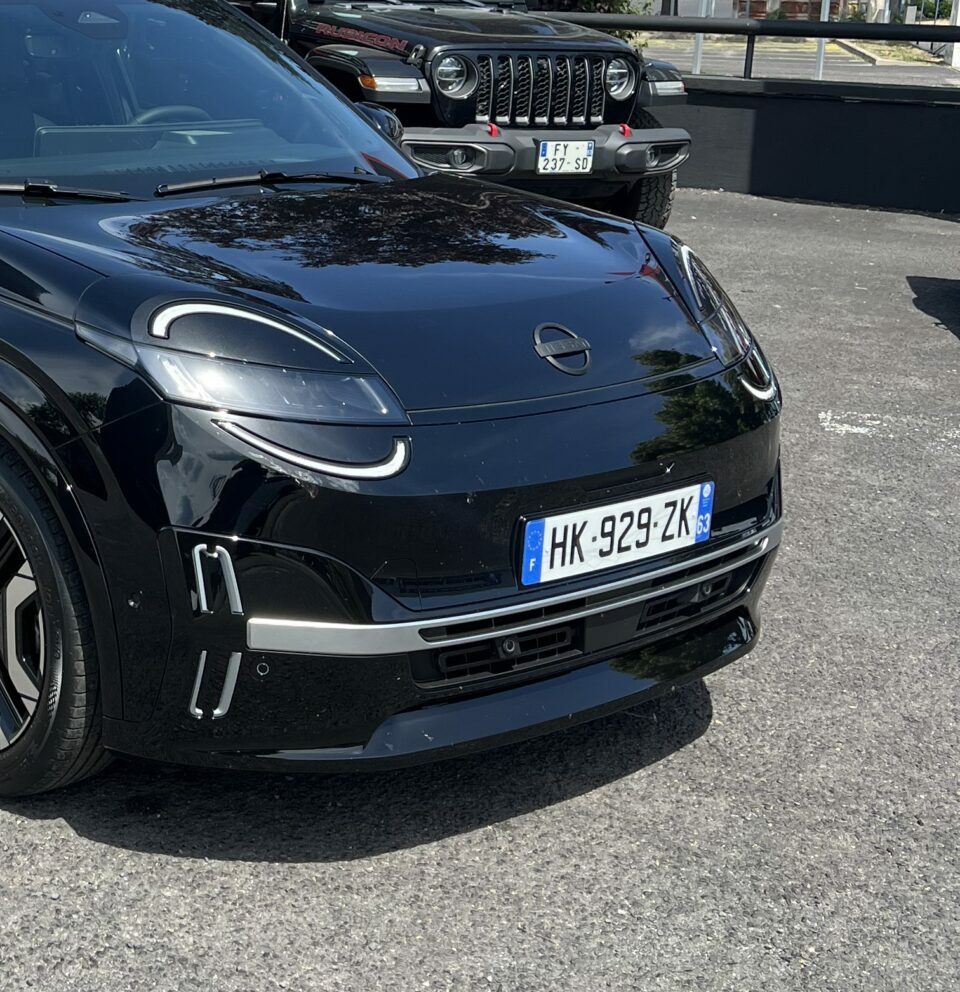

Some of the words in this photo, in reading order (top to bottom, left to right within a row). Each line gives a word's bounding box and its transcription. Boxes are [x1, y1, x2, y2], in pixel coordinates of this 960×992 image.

[316, 22, 409, 50] RUBICON
[696, 512, 711, 535] 63
[529, 558, 536, 572] F
